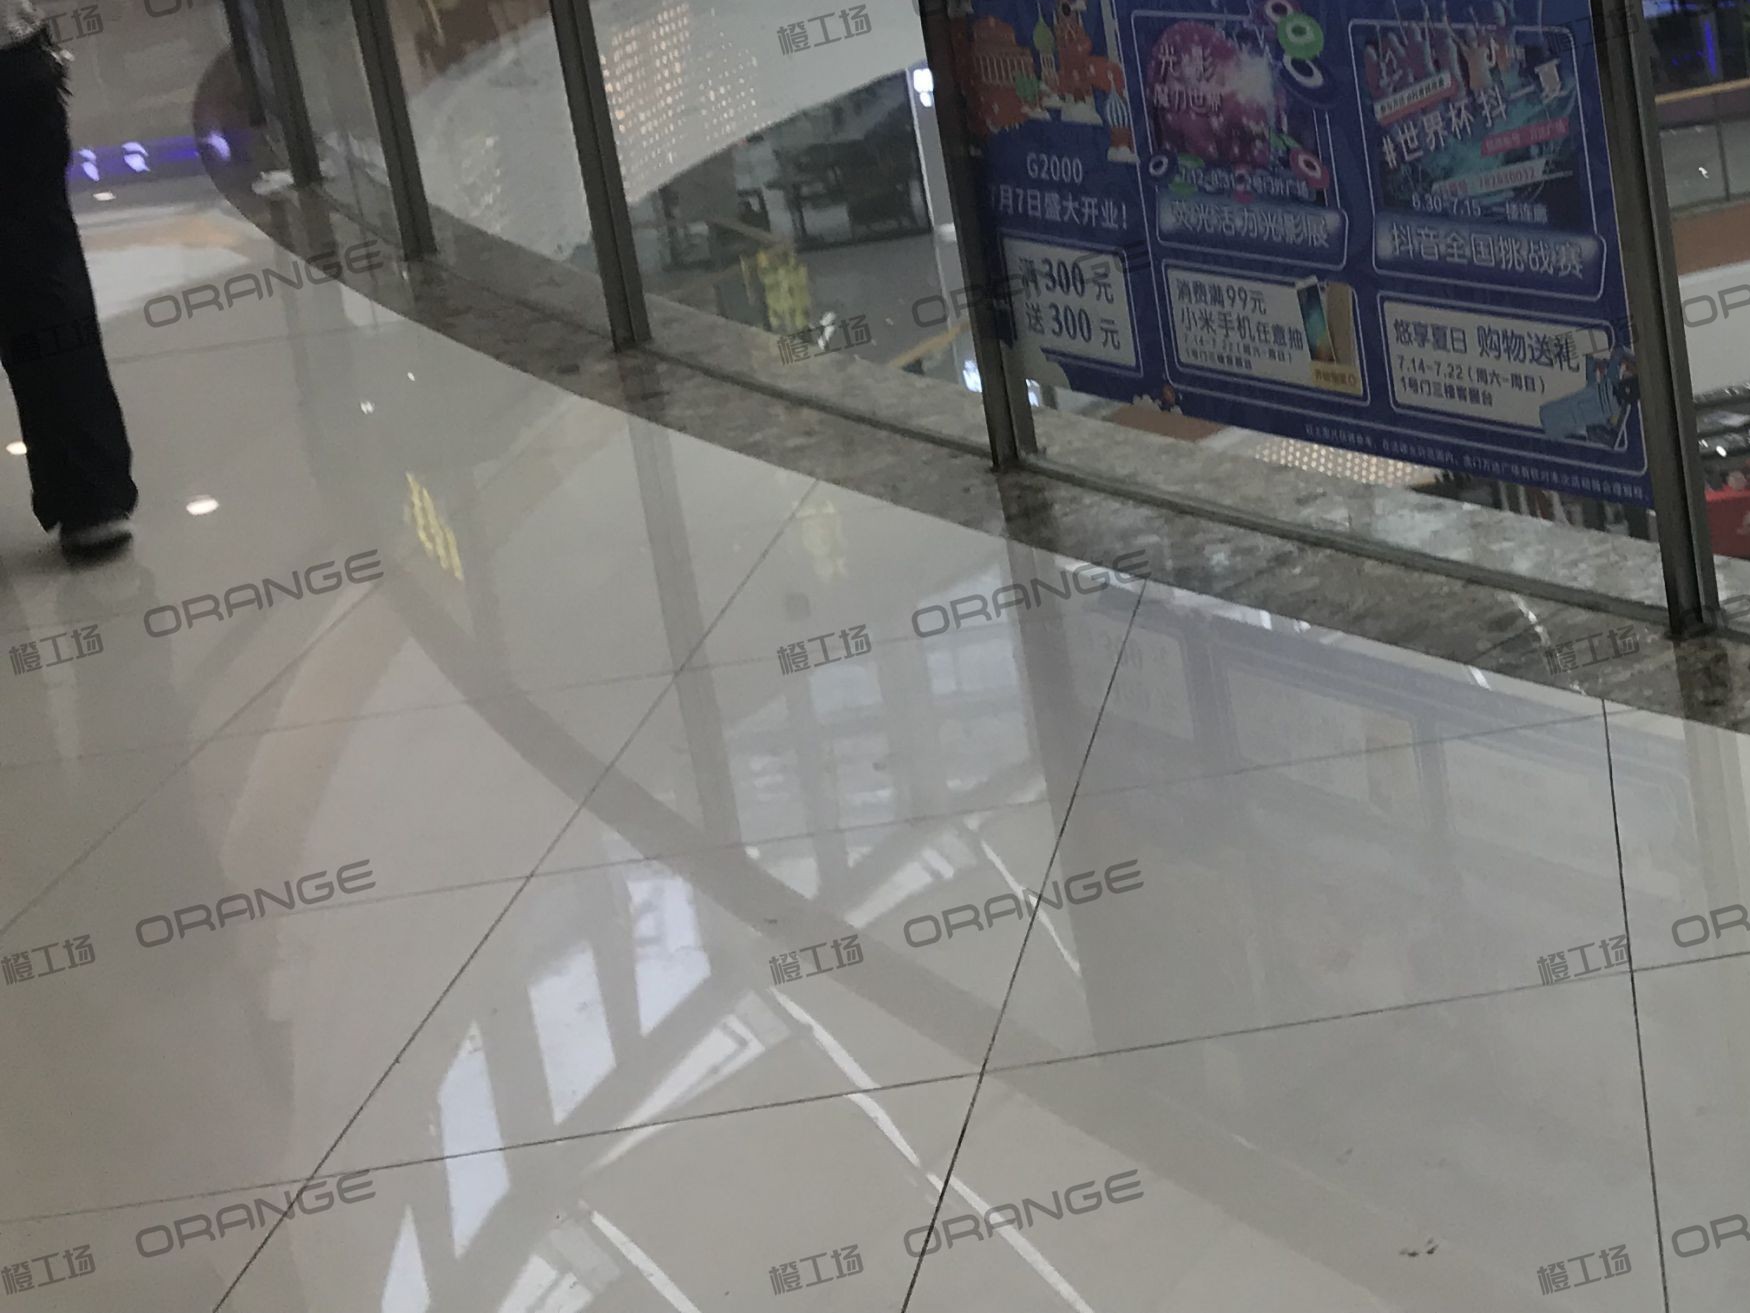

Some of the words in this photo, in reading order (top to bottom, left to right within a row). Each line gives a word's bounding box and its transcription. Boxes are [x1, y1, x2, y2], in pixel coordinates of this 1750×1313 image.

[1026, 153, 1083, 184] G2000
[1391, 221, 1584, 280] 抖音全国挑战赛
[1176, 278, 1267, 316] 消费满99元
[1180, 306, 1305, 351] 小米手机任意抽
[1393, 318, 1468, 353] 悠享夏日
[1476, 325, 1581, 373] 购物送礼
